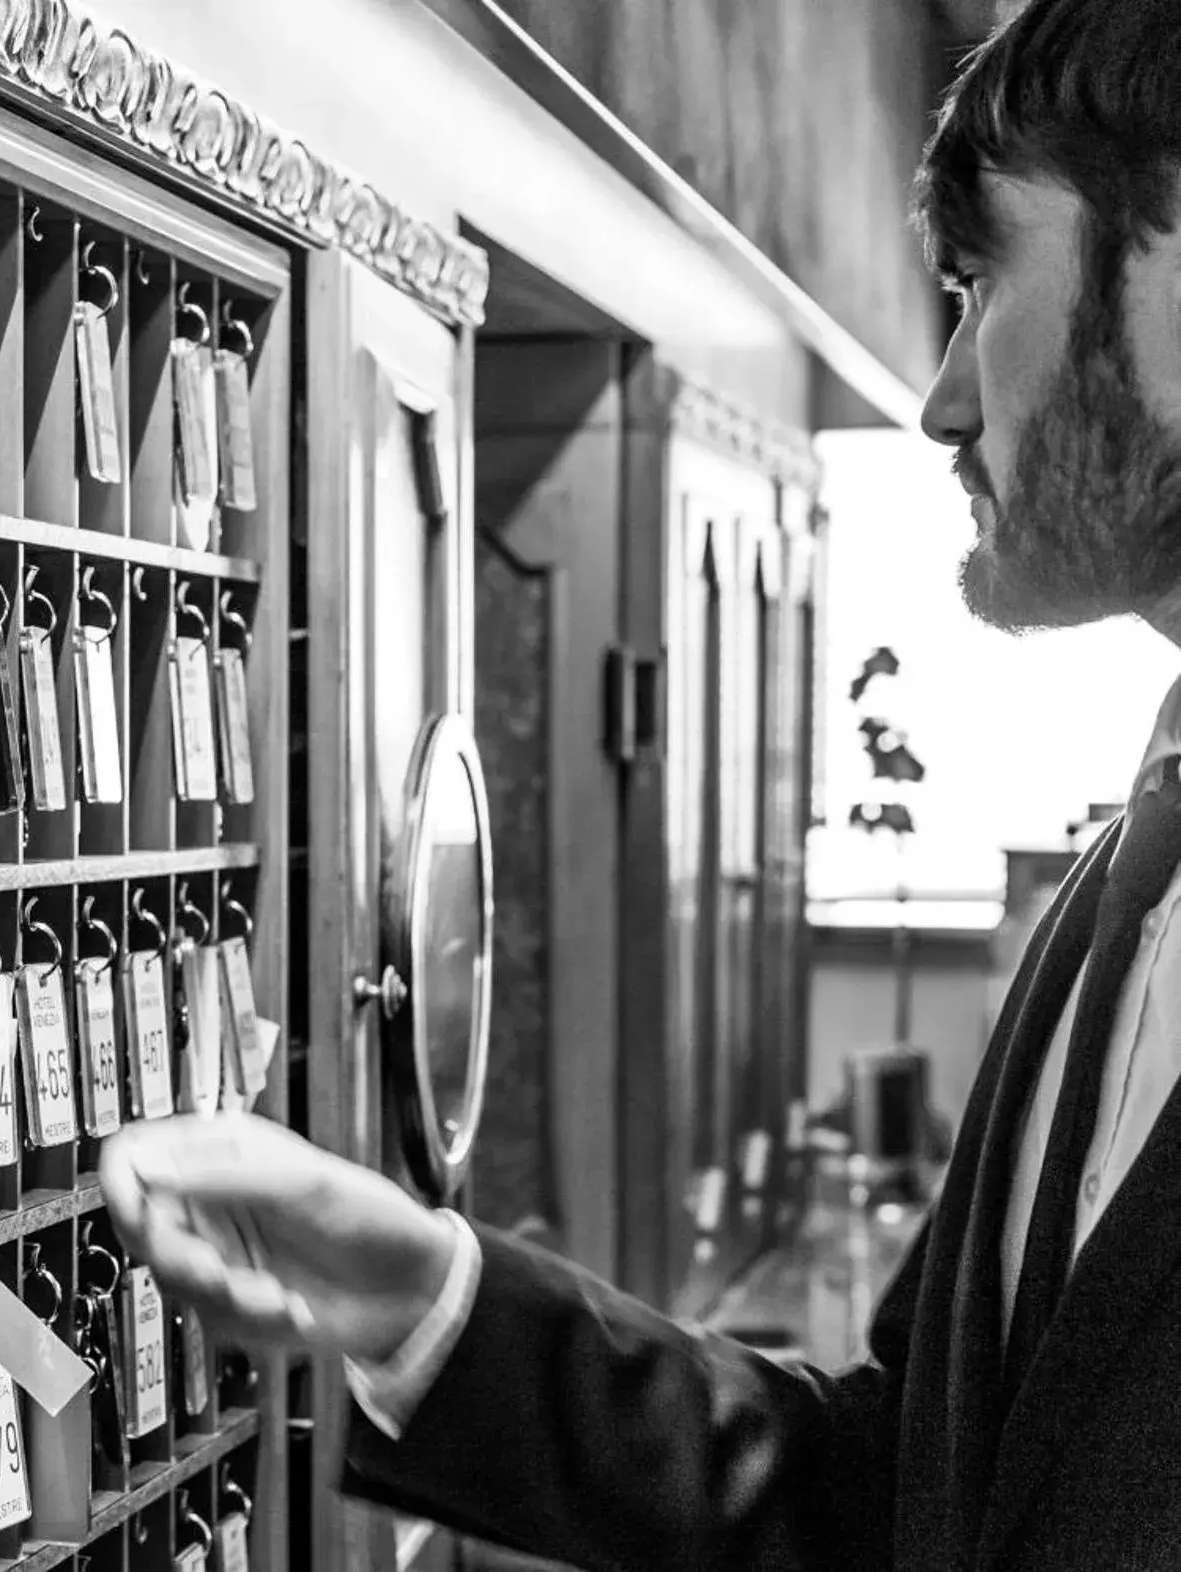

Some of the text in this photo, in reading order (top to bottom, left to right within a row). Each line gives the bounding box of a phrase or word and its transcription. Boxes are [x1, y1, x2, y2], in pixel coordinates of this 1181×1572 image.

[33, 996, 56, 1010] HOTEL
[36, 1049, 71, 1101] 465
[92, 1039, 116, 1092] 466
[142, 1029, 165, 1074] 467
[44, 1121, 72, 1138] MESTRE
[137, 1339, 163, 1394] 582
